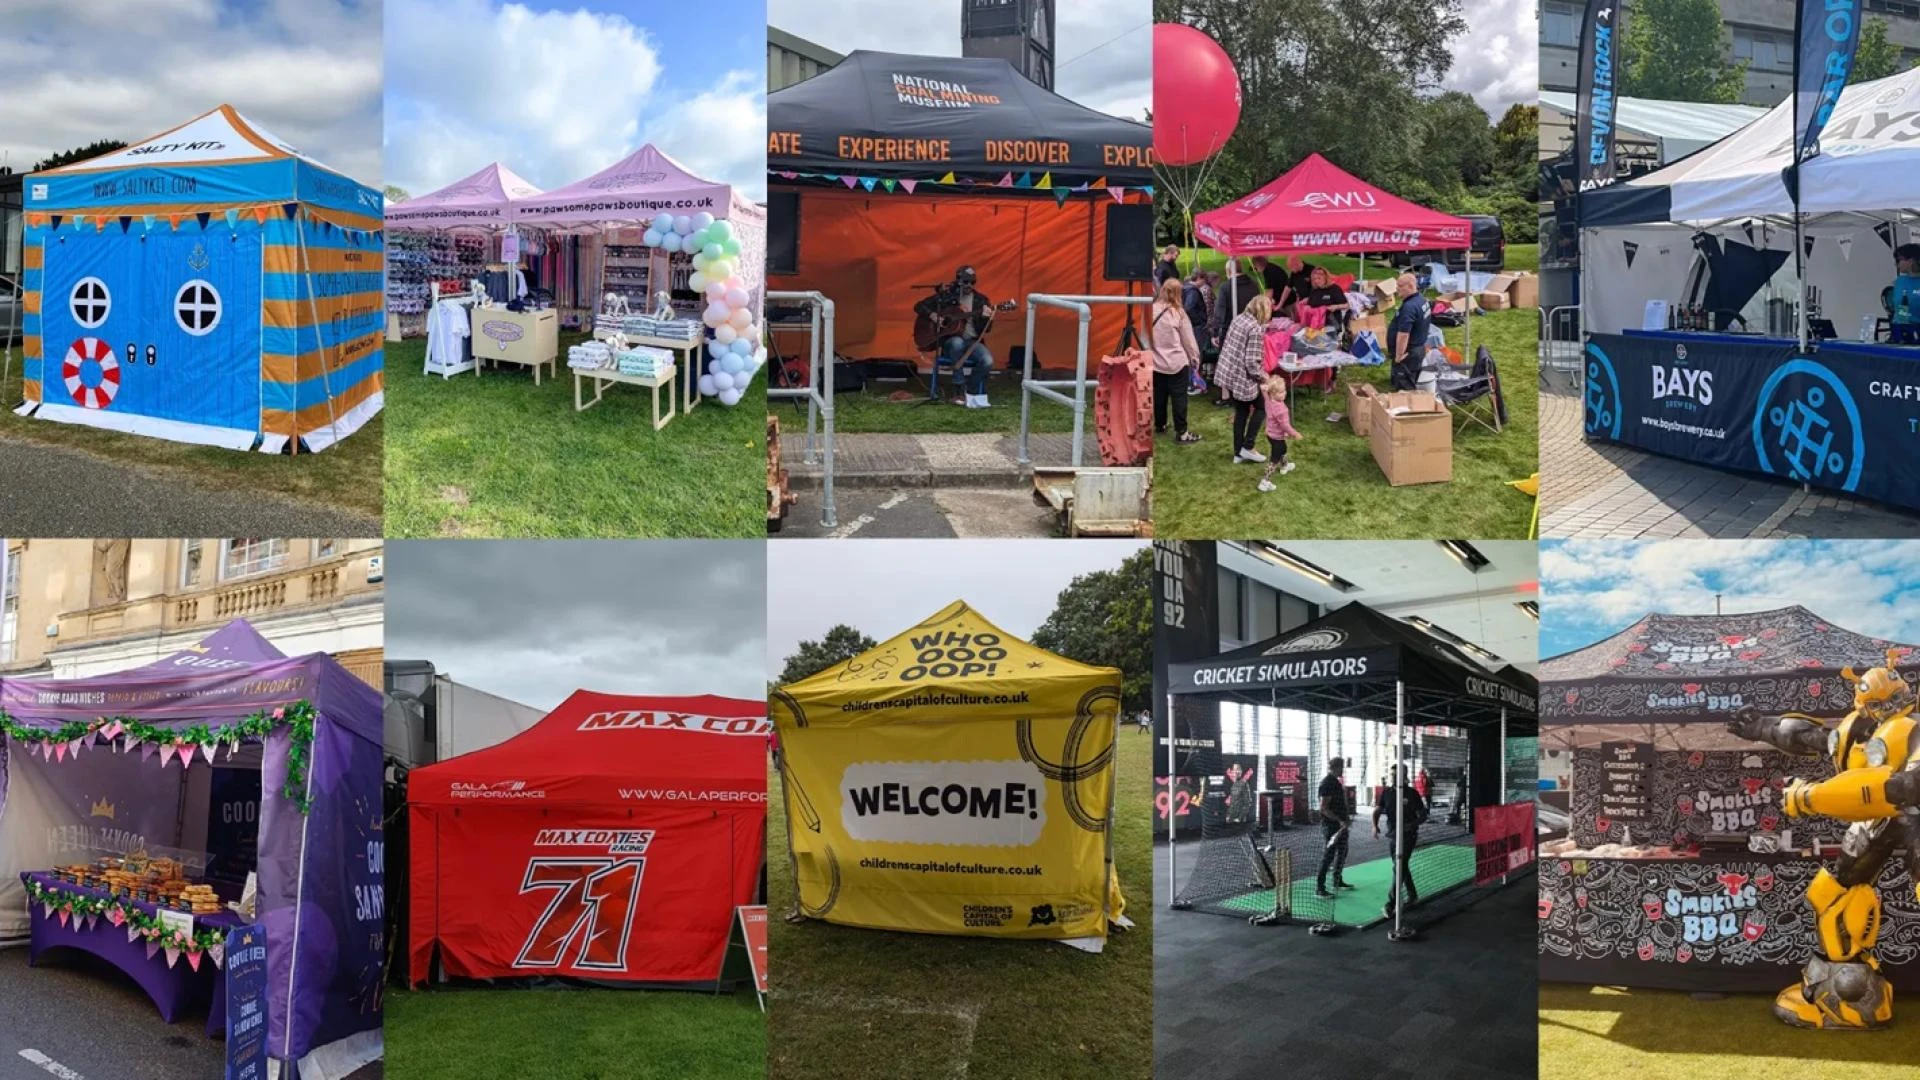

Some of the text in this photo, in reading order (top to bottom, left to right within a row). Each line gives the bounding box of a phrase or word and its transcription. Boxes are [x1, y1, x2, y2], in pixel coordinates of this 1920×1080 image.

[892, 73, 967, 94] NATIONAL
[1590, 22, 1613, 165] DEVON ROCK
[895, 84, 1001, 105] COAL MINING
[898, 93, 971, 108] MUSEUM
[127, 141, 221, 156] SALTY KIT
[768, 131, 802, 155] ATE
[839, 136, 950, 161] EXPERIENCE
[985, 140, 1070, 163] DISCOVER
[520, 197, 714, 215] www.pawsomepawsboutique.co.uk
[1302, 190, 1377, 209] CWU
[1291, 229, 1421, 246] www.cwu.org
[1652, 365, 1713, 406] BAYS
[1152, 547, 1184, 580] YOU
[1164, 576, 1185, 605] UA
[1163, 602, 1185, 629] 92
[910, 631, 1000, 650] WHO
[917, 647, 1007, 664] OOO
[1667, 651, 1732, 663] BBQ
[900, 662, 998, 682] OOP!
[1194, 657, 1368, 685] CRICKET SIMULATORS
[842, 690, 1029, 712] childrenscapitalofculture.co.uk
[1465, 676, 1536, 713] CRICKET SIMULATORS
[1707, 693, 1743, 710] BBQ
[583, 711, 691, 731] MAX
[451, 782, 488, 790] GALA
[451, 790, 545, 799] PERFORMANCE
[849, 782, 1038, 820] WELCOME!
[1711, 808, 1757, 831] BBQ
[537, 831, 651, 845] MAX COATES
[611, 845, 646, 853] RACING
[859, 857, 1043, 876] childrenscapitalofculture.co.uk
[511, 857, 648, 972] 71
[1683, 912, 1739, 942] BBQ
